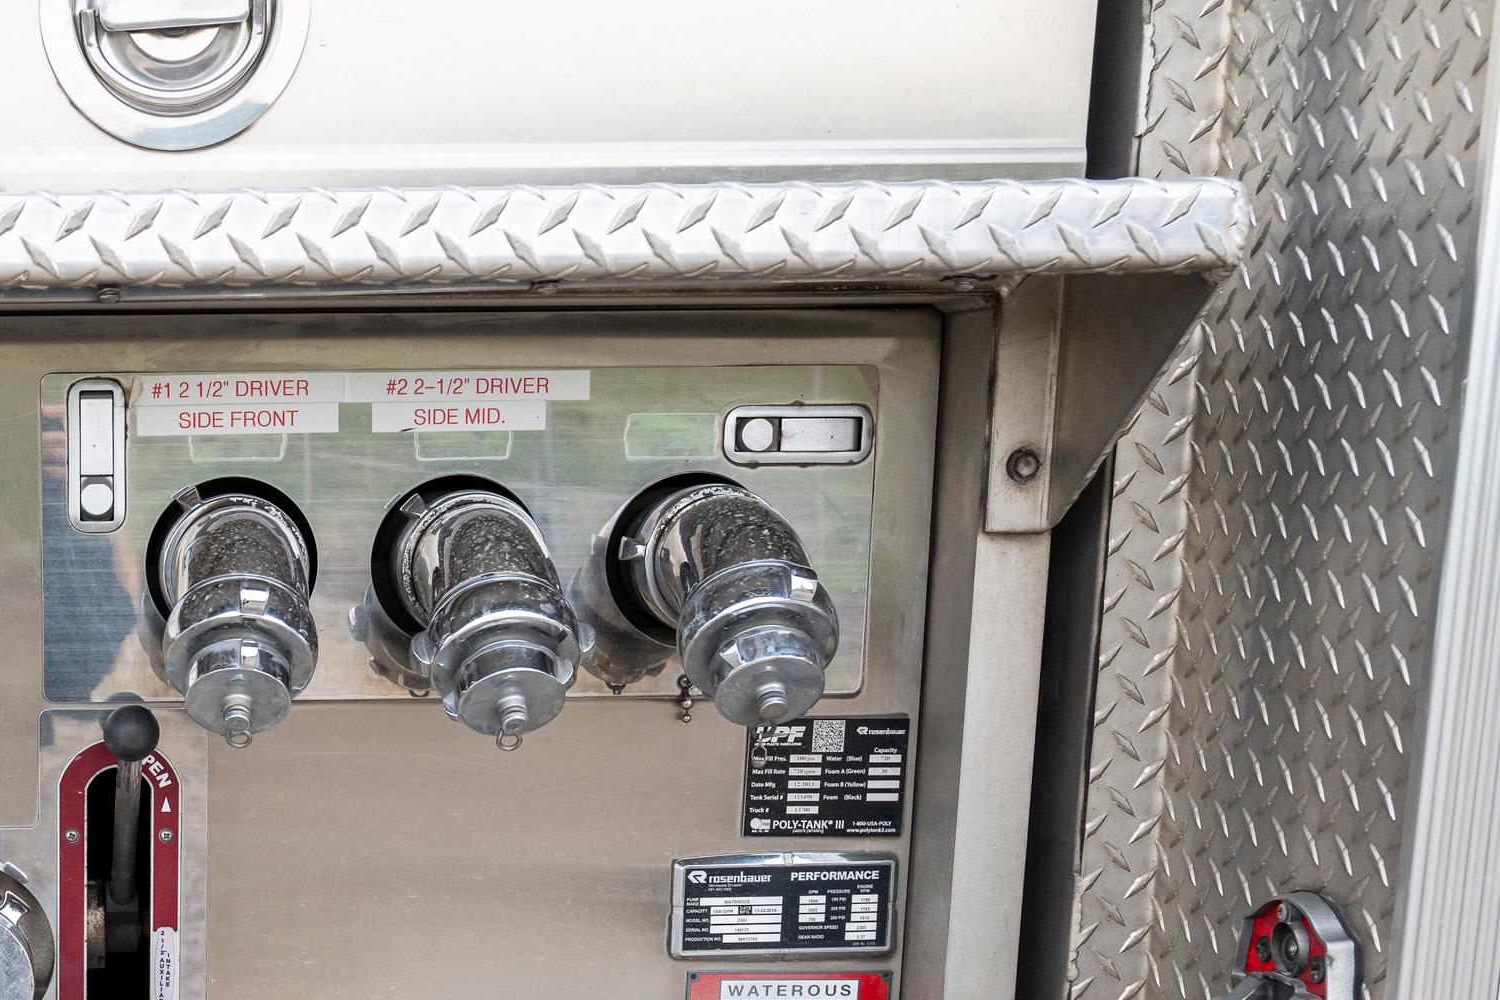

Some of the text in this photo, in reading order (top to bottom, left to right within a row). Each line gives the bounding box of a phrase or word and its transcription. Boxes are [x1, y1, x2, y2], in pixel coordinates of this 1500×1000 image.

[151, 379, 309, 399] #1 2 1/2" DRIVER
[385, 379, 408, 396] #2
[475, 377, 549, 395] DRIVER
[178, 410, 299, 430] SIDE FRONT
[413, 407, 506, 426] SIDE MID.
[141, 754, 172, 788] PEN
[835, 820, 844, 830] III
[708, 870, 772, 884] rosenbauer
[790, 870, 880, 881] PERFORMANCE
[728, 984, 852, 997] WATEROUS
